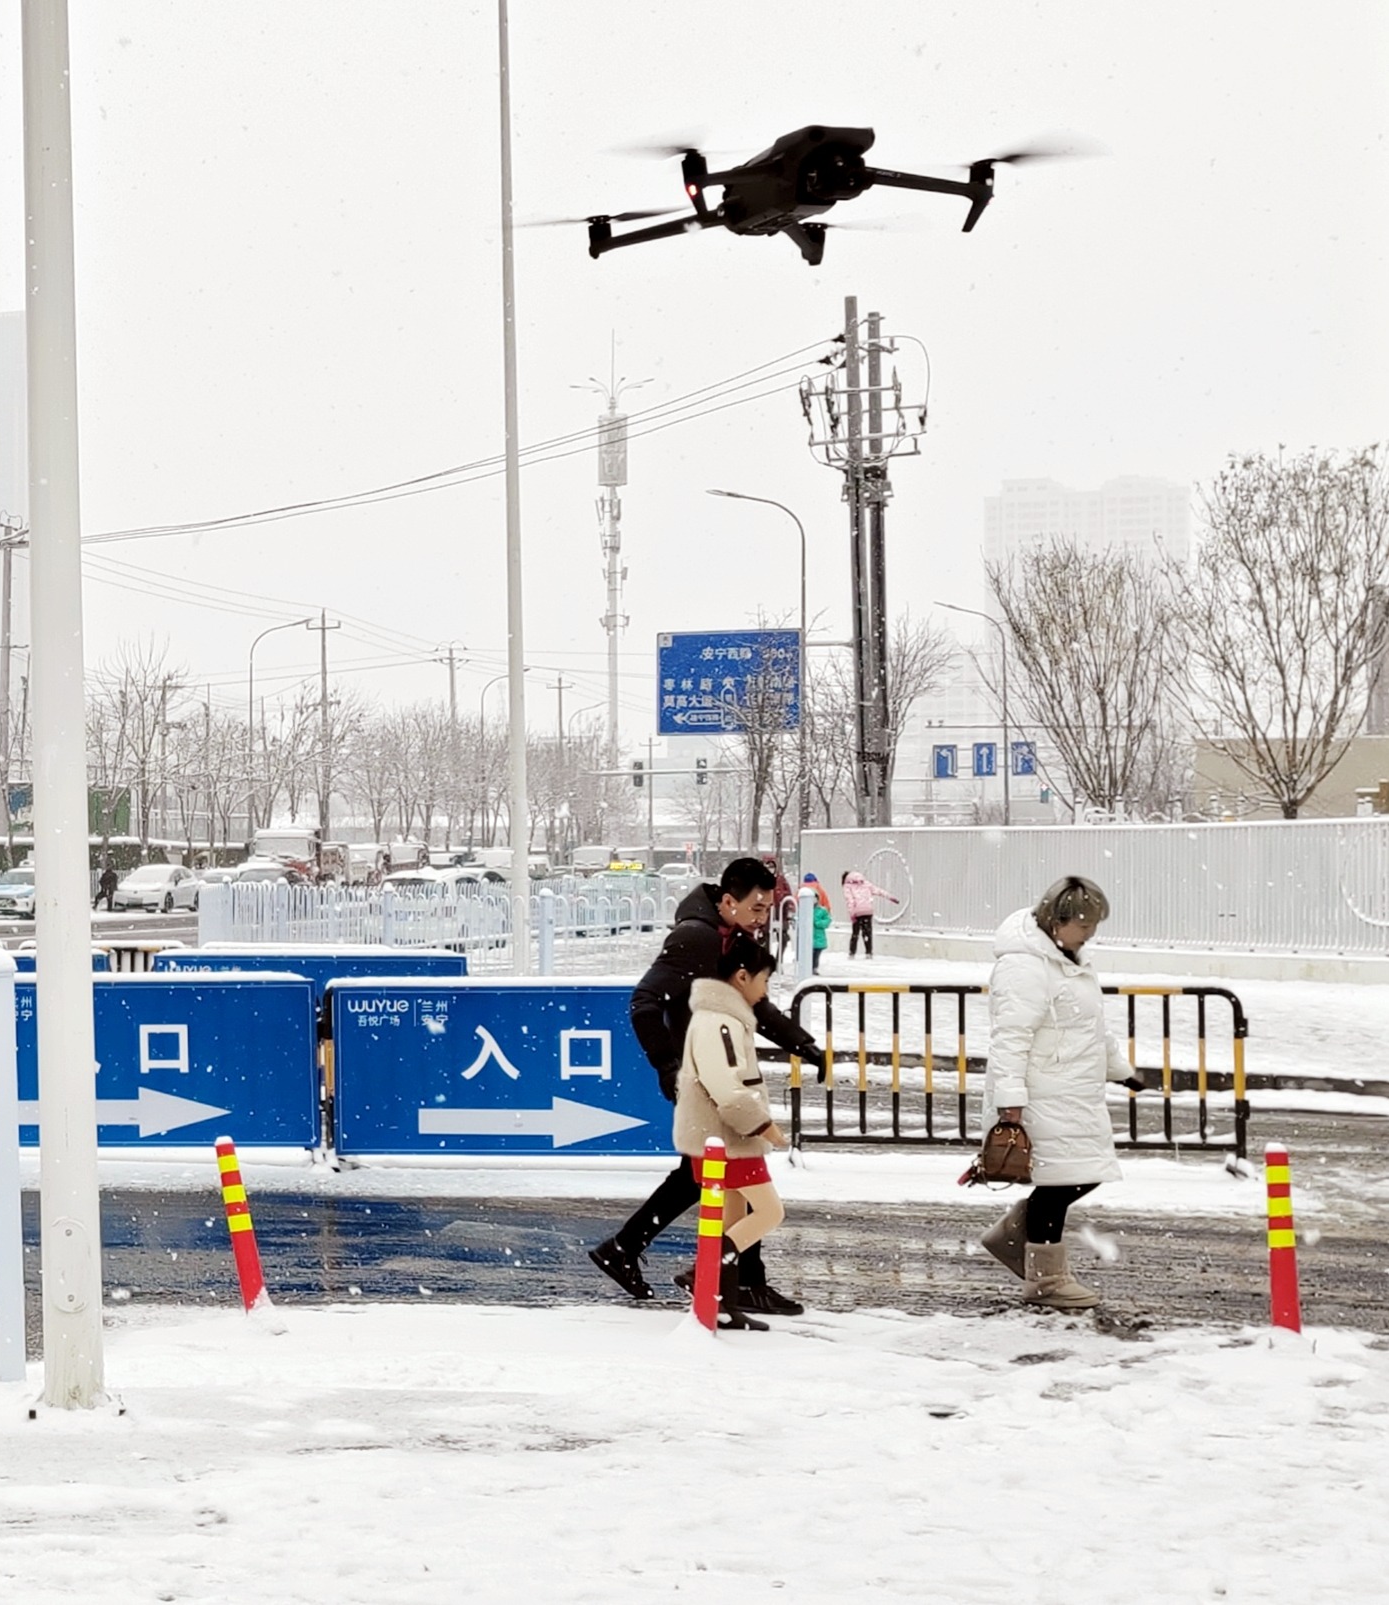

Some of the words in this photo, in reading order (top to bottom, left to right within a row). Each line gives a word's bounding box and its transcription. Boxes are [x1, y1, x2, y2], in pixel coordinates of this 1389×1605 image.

[421, 1000, 448, 1012] 兰州
[357, 1015, 401, 1027] 吾悦广场
[461, 1024, 612, 1080] 入口
